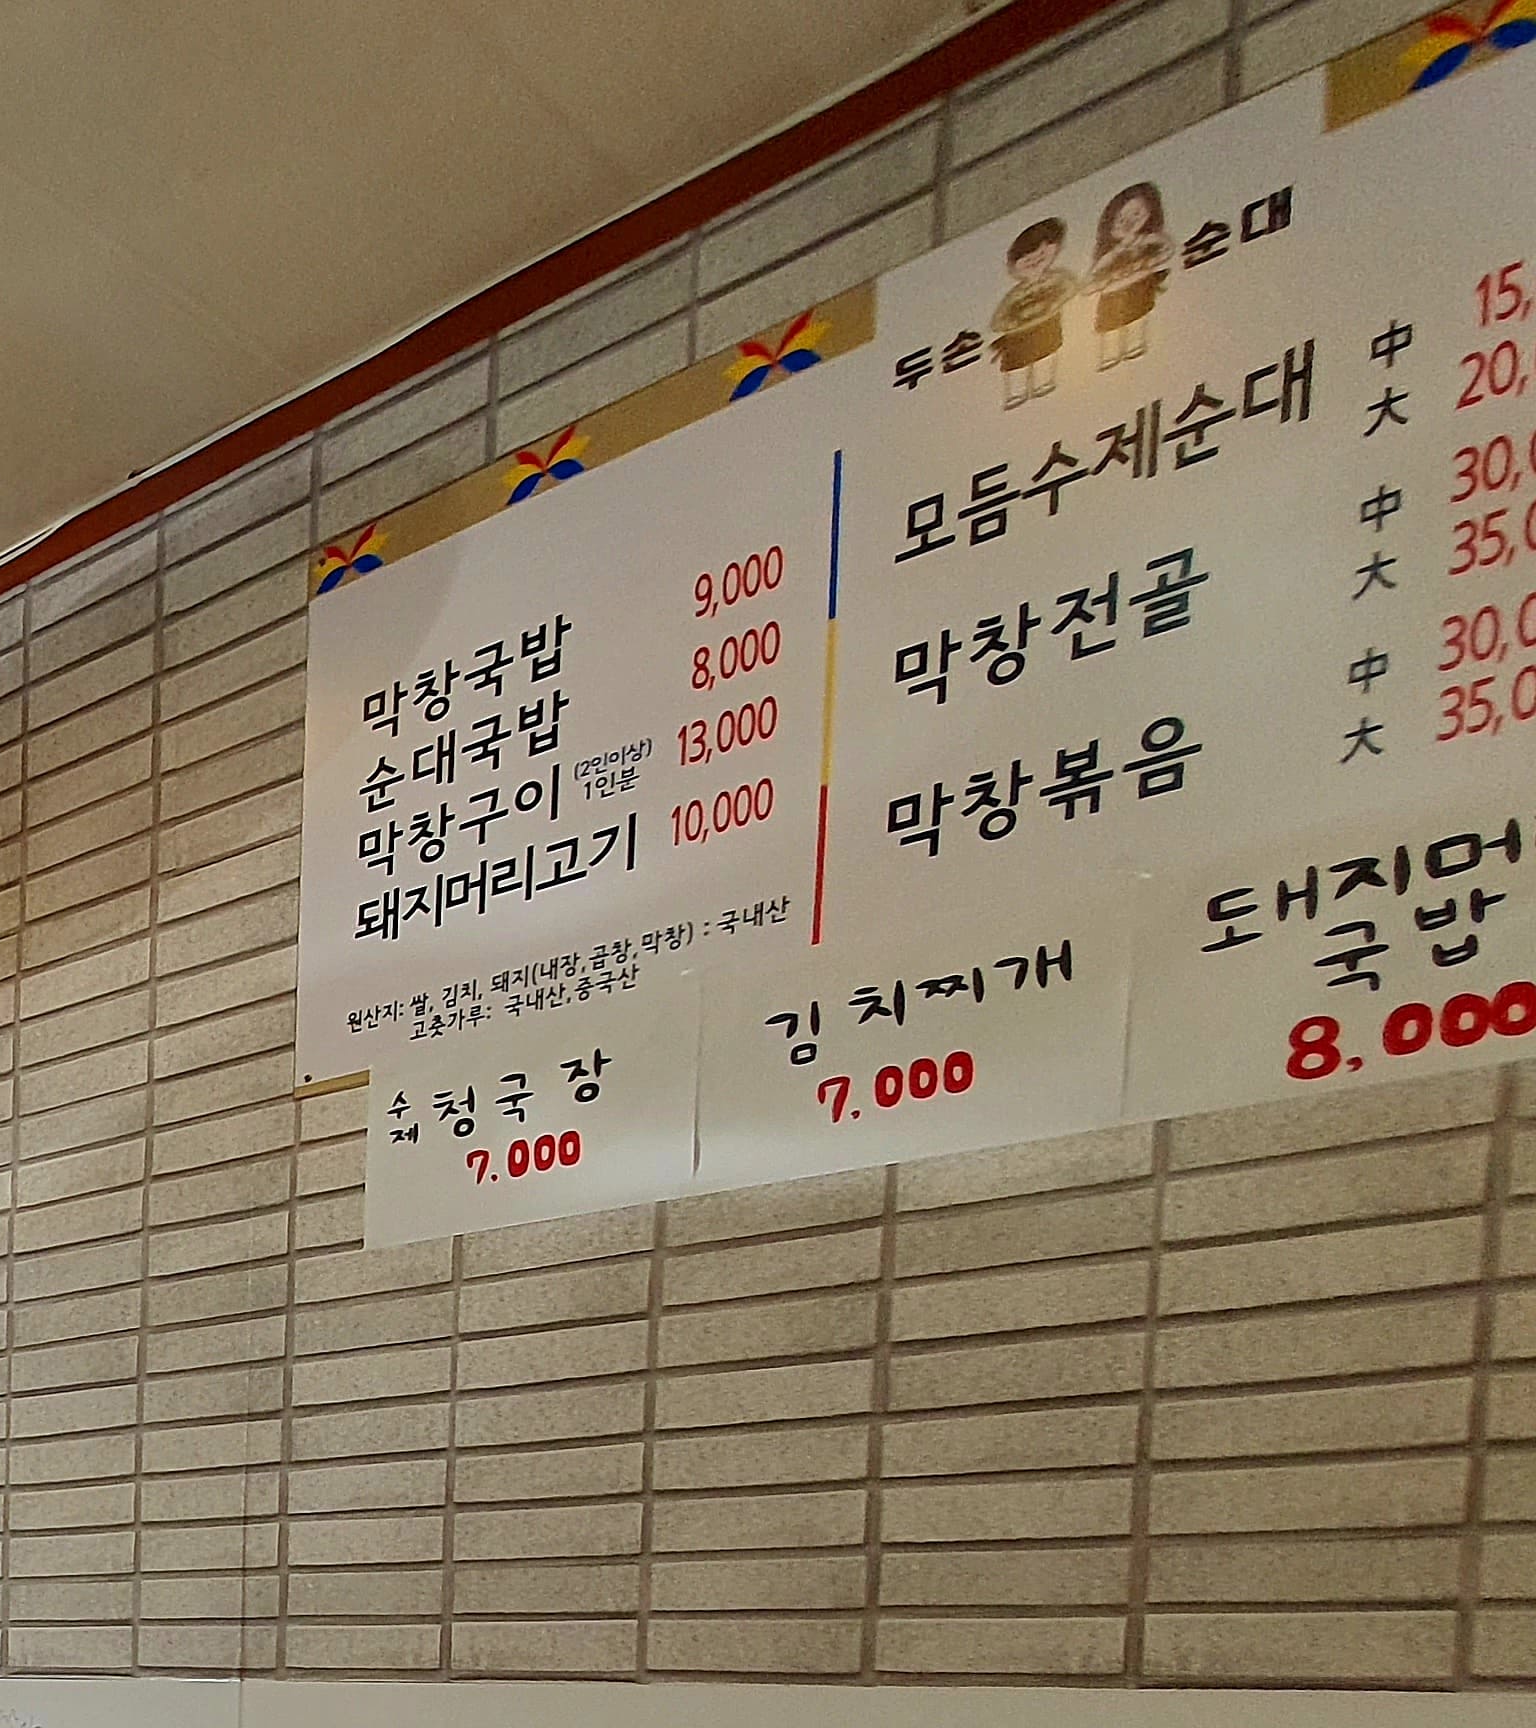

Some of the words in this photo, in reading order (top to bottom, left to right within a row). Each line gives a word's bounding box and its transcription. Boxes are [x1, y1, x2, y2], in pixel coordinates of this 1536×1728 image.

[1181, 184, 1295, 270] 순대
[1369, 319, 1413, 369] 中
[1363, 386, 1410, 437] 大
[894, 338, 1316, 564] 모듬수제순대
[1450, 431, 1536, 503] 30,
[1360, 483, 1403, 533] 中
[693, 545, 785, 617] 9,000
[1352, 550, 1398, 601] 大
[690, 620, 782, 691] 8,000
[894, 547, 1211, 705] 막창전골
[361, 613, 573, 738] 막창국밥
[1348, 646, 1389, 694] 中
[358, 688, 570, 813] 순대국밥
[573, 737, 654, 783] (2인이상)
[676, 695, 779, 767] 13,000
[1339, 716, 1385, 764] 大
[358, 763, 562, 876] 막창구이
[583, 767, 641, 801] 1인분
[670, 777, 775, 847] 10,000
[887, 716, 1203, 858] 막창볶음
[353, 812, 638, 941] 돼지머리고기
[1200, 815, 1536, 953] 돼지머
[716, 895, 791, 935] 국내산
[1314, 887, 1508, 992] 국밥
[818, 1050, 975, 1125] 7.000
[466, 1130, 581, 1186] 7.000
